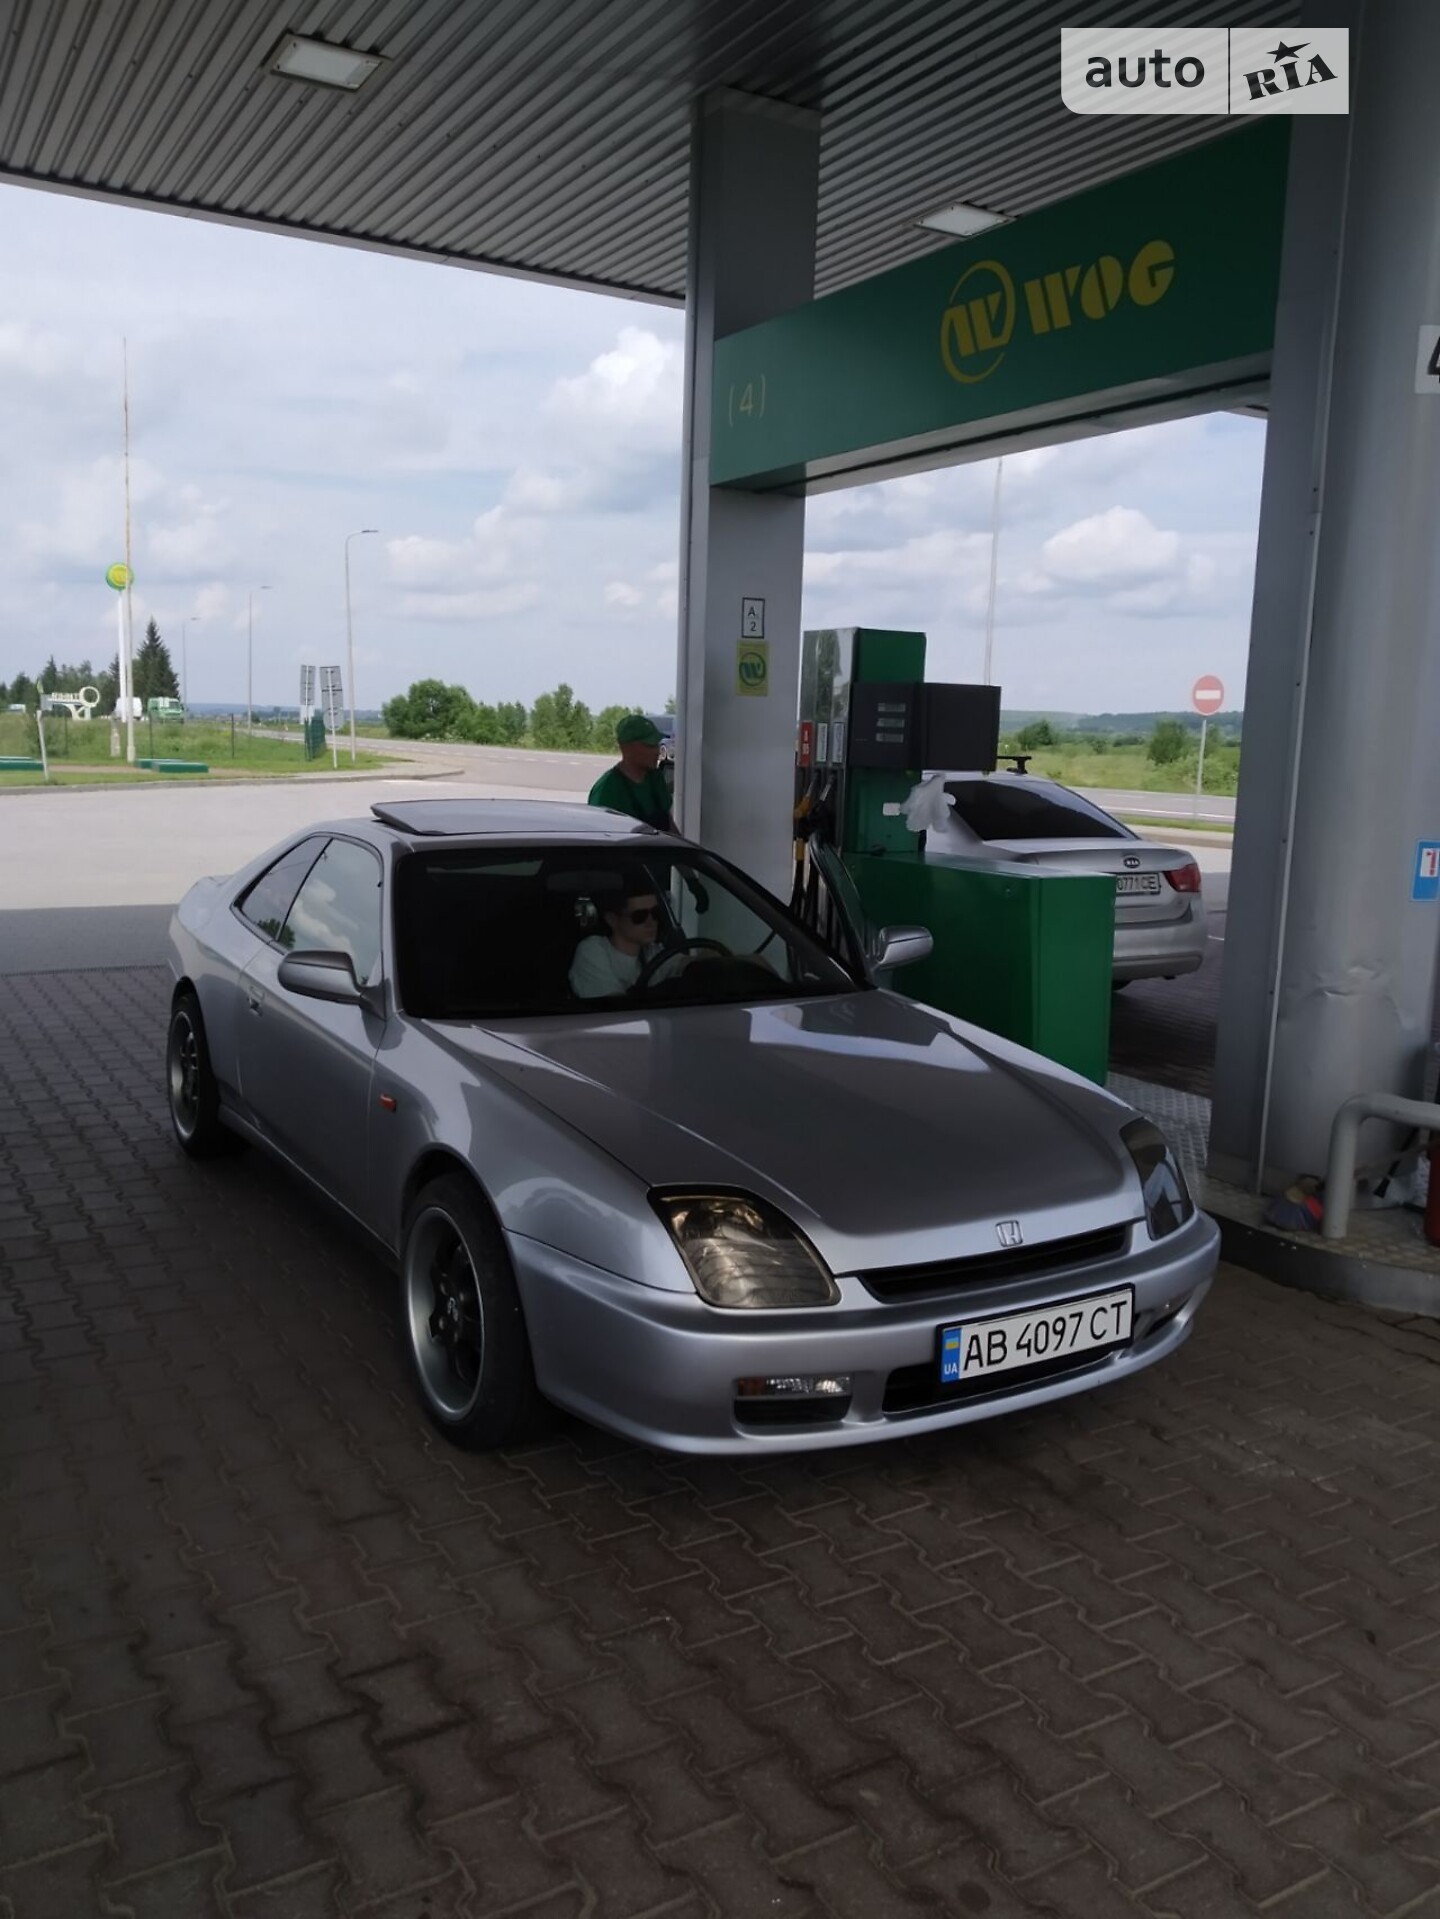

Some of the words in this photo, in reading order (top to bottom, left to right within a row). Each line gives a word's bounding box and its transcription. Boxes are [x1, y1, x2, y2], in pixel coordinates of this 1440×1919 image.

[1024, 240, 1175, 335] WOG
[747, 606, 756, 617] A
[750, 621, 757, 632] 2
[963, 1330, 1007, 1371] AB
[1016, 1312, 1083, 1358] 4097
[1090, 1301, 1127, 1340] CT
[944, 1362, 958, 1375] UA
